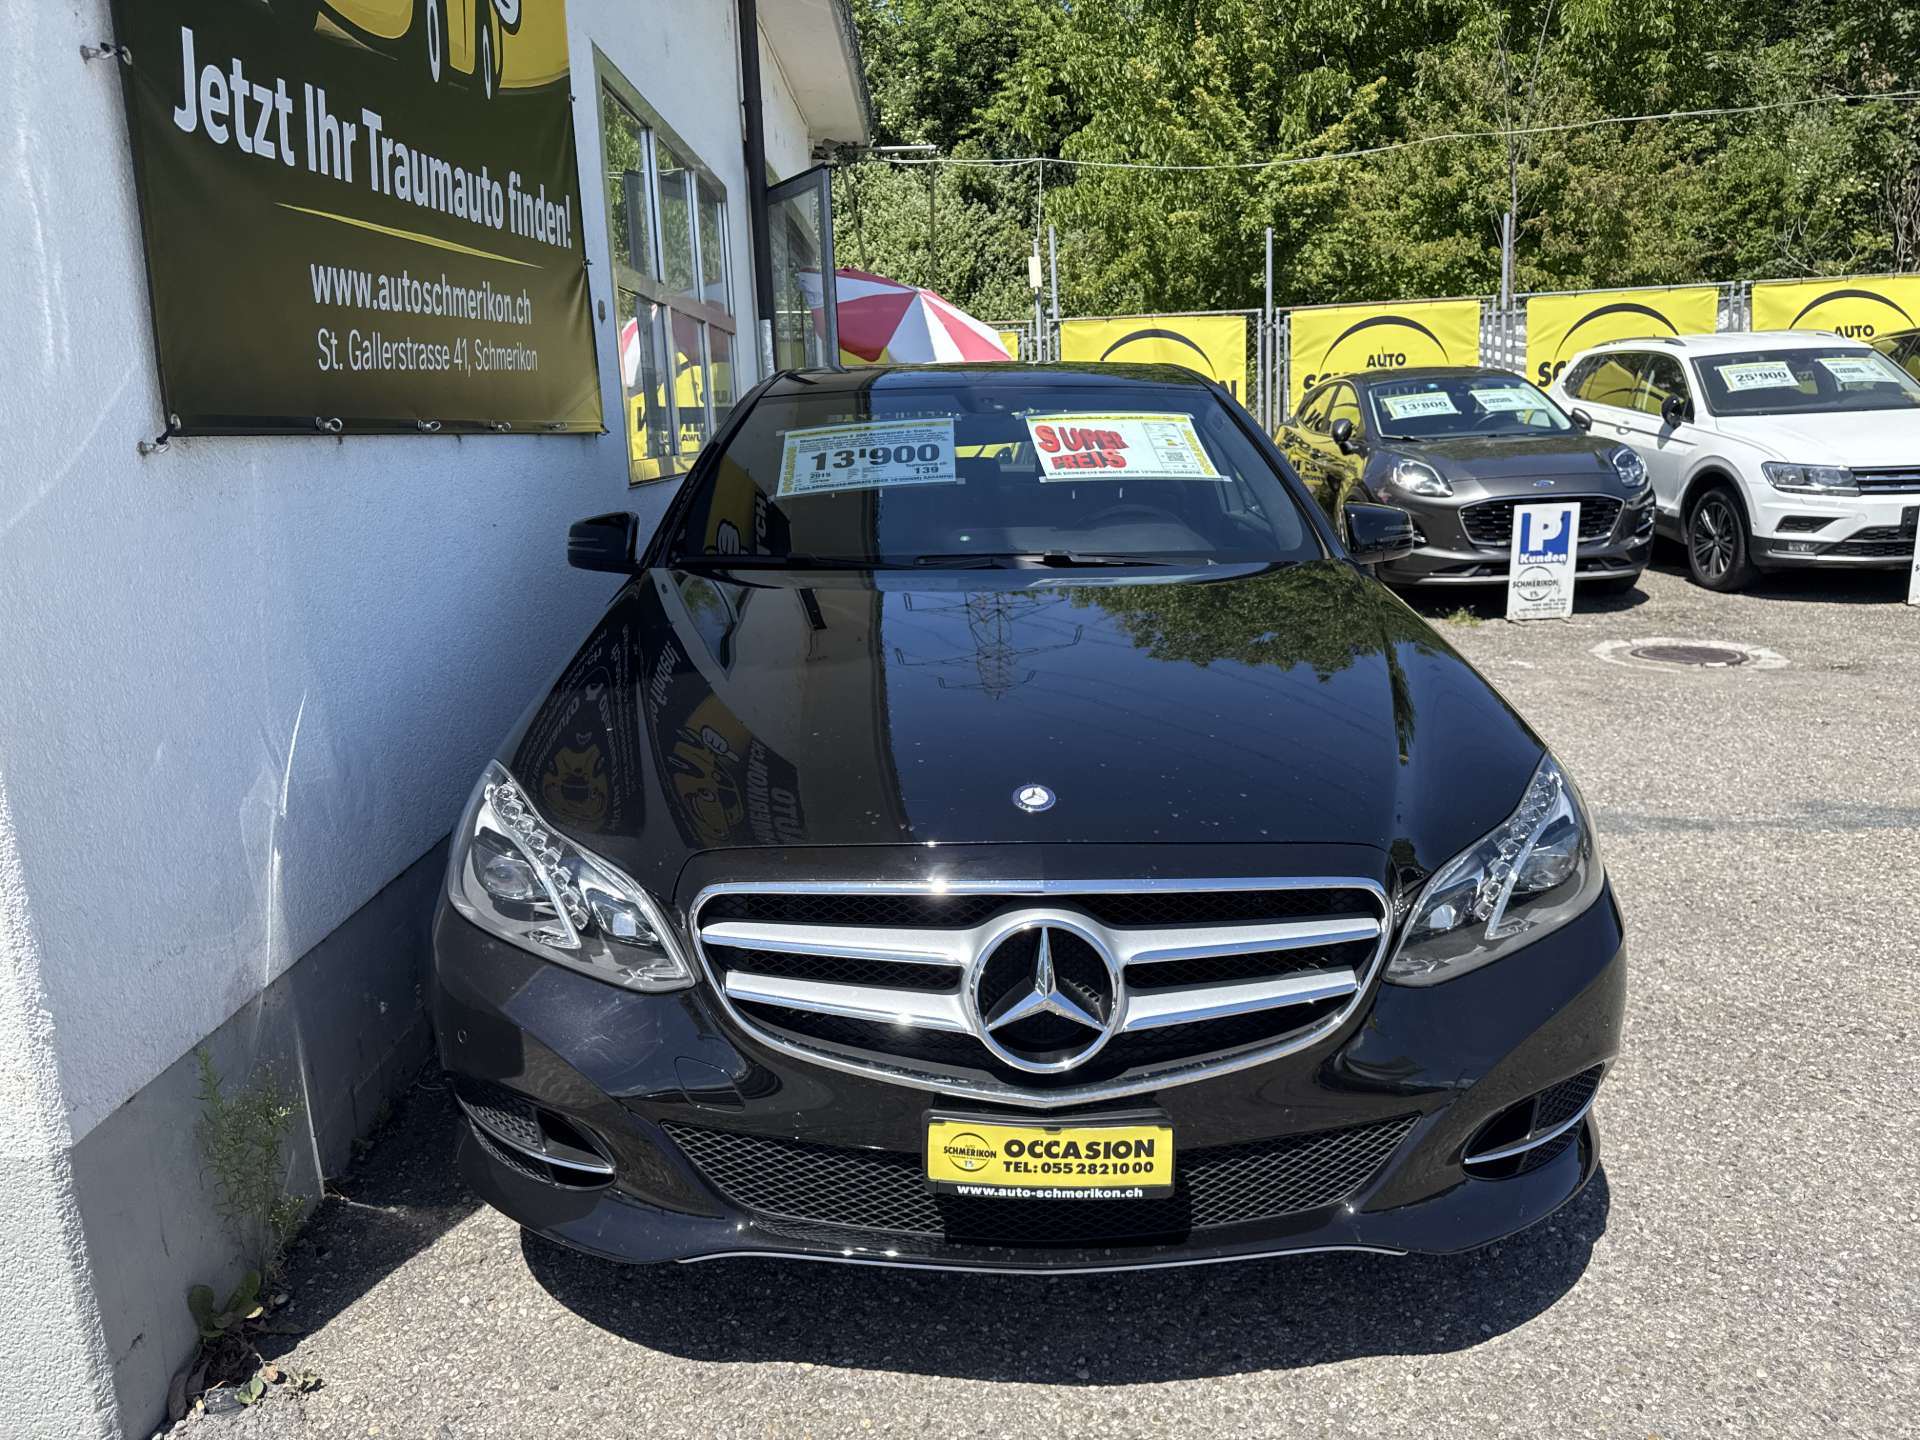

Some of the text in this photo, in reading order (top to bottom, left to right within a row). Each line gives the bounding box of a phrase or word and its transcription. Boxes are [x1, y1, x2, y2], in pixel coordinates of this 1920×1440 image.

[173, 26, 572, 249] Jetzt Ihr Traumauto finden!
[310, 263, 532, 325] www.autoschmerikon.ch
[1834, 324, 1875, 338] AUTO
[317, 327, 538, 377] St. Gallerstrasse 41, Schmerikon
[1366, 353, 1407, 368] AUTO
[1735, 372, 1788, 382] 25'900
[1035, 425, 1130, 453] SUPER
[811, 443, 940, 471] 13'900
[1051, 449, 1127, 470] PREIS
[1519, 552, 1567, 564] Kunden
[1513, 580, 1559, 589] SCHMERIKON
[943, 1146, 997, 1159] SCHMERIKON
[1003, 1139, 1155, 1160] OCCASION
[1003, 1161, 1038, 1174] TEL:
[1041, 1162, 1073, 1175] 055
[956, 1185, 1144, 1199] www.auto-schmerikon.ch
